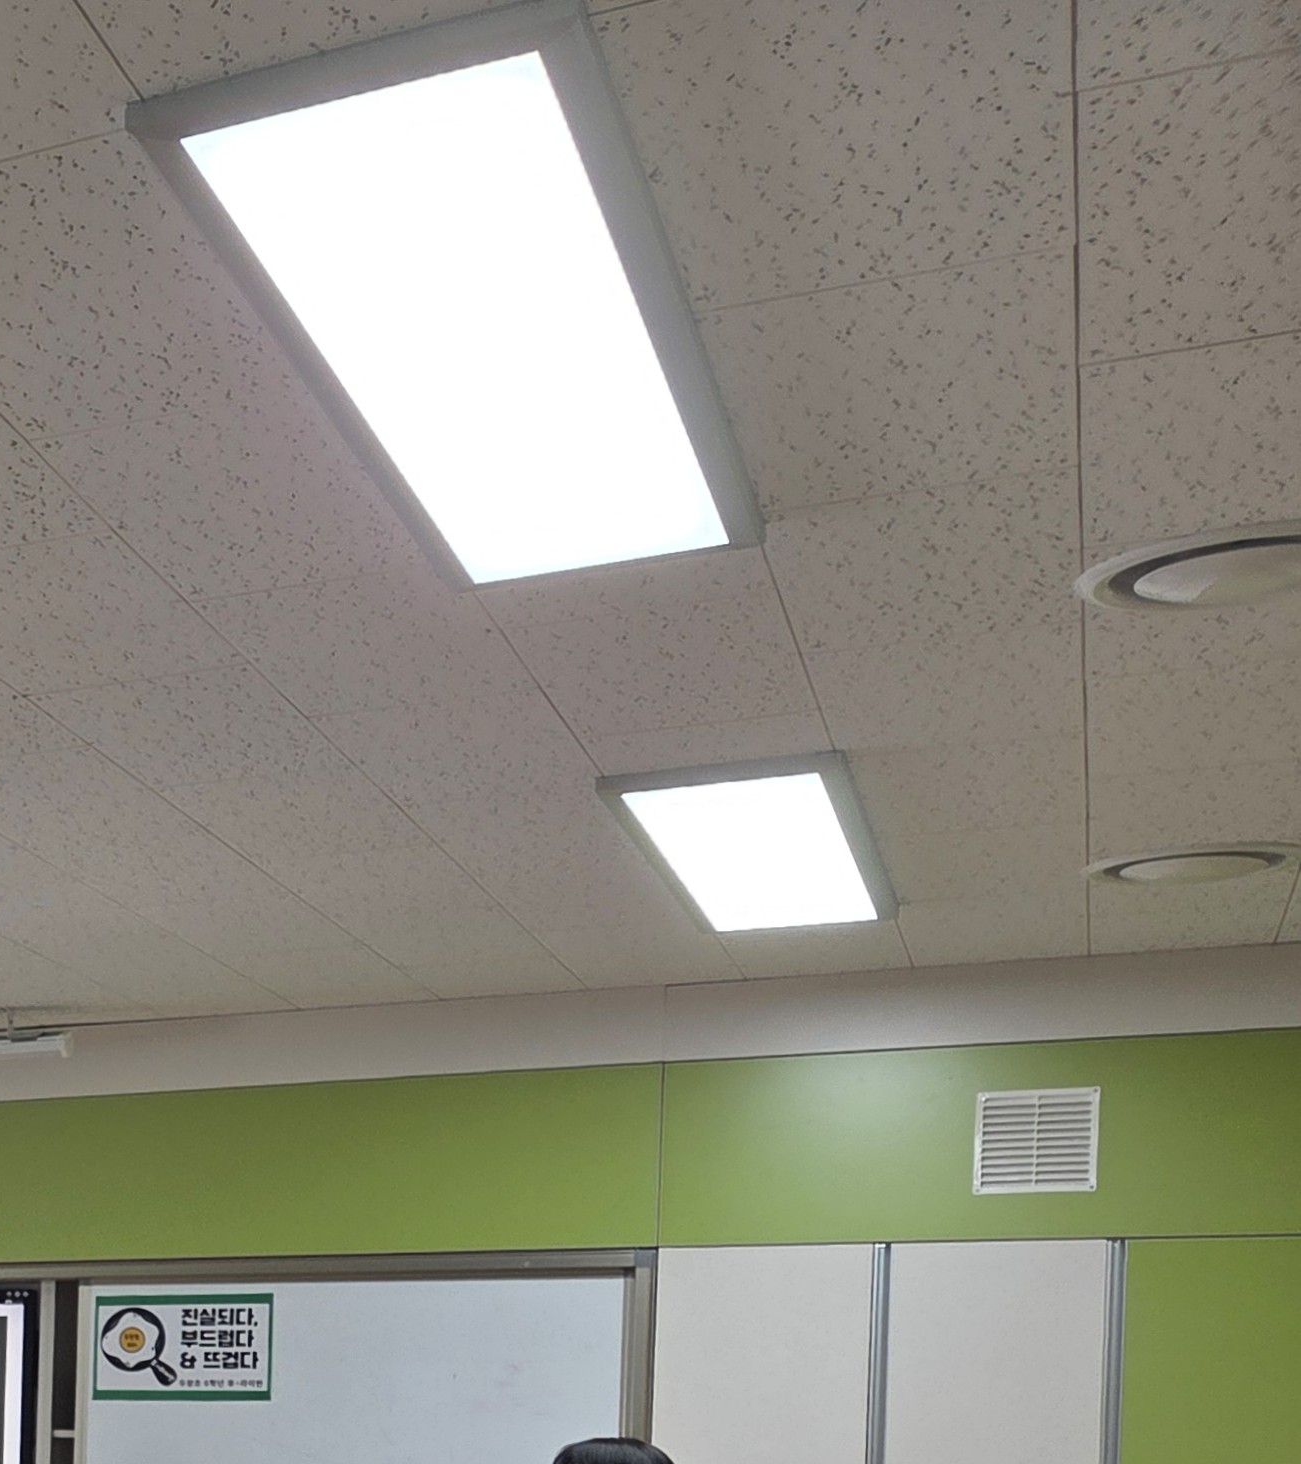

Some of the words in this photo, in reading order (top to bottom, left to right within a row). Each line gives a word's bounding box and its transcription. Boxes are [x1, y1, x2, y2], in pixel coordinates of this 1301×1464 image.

[181, 1308, 258, 1327] 진실되다,
[180, 1329, 254, 1348] 부드럽다
[203, 1351, 259, 1369] 뜨겁다
